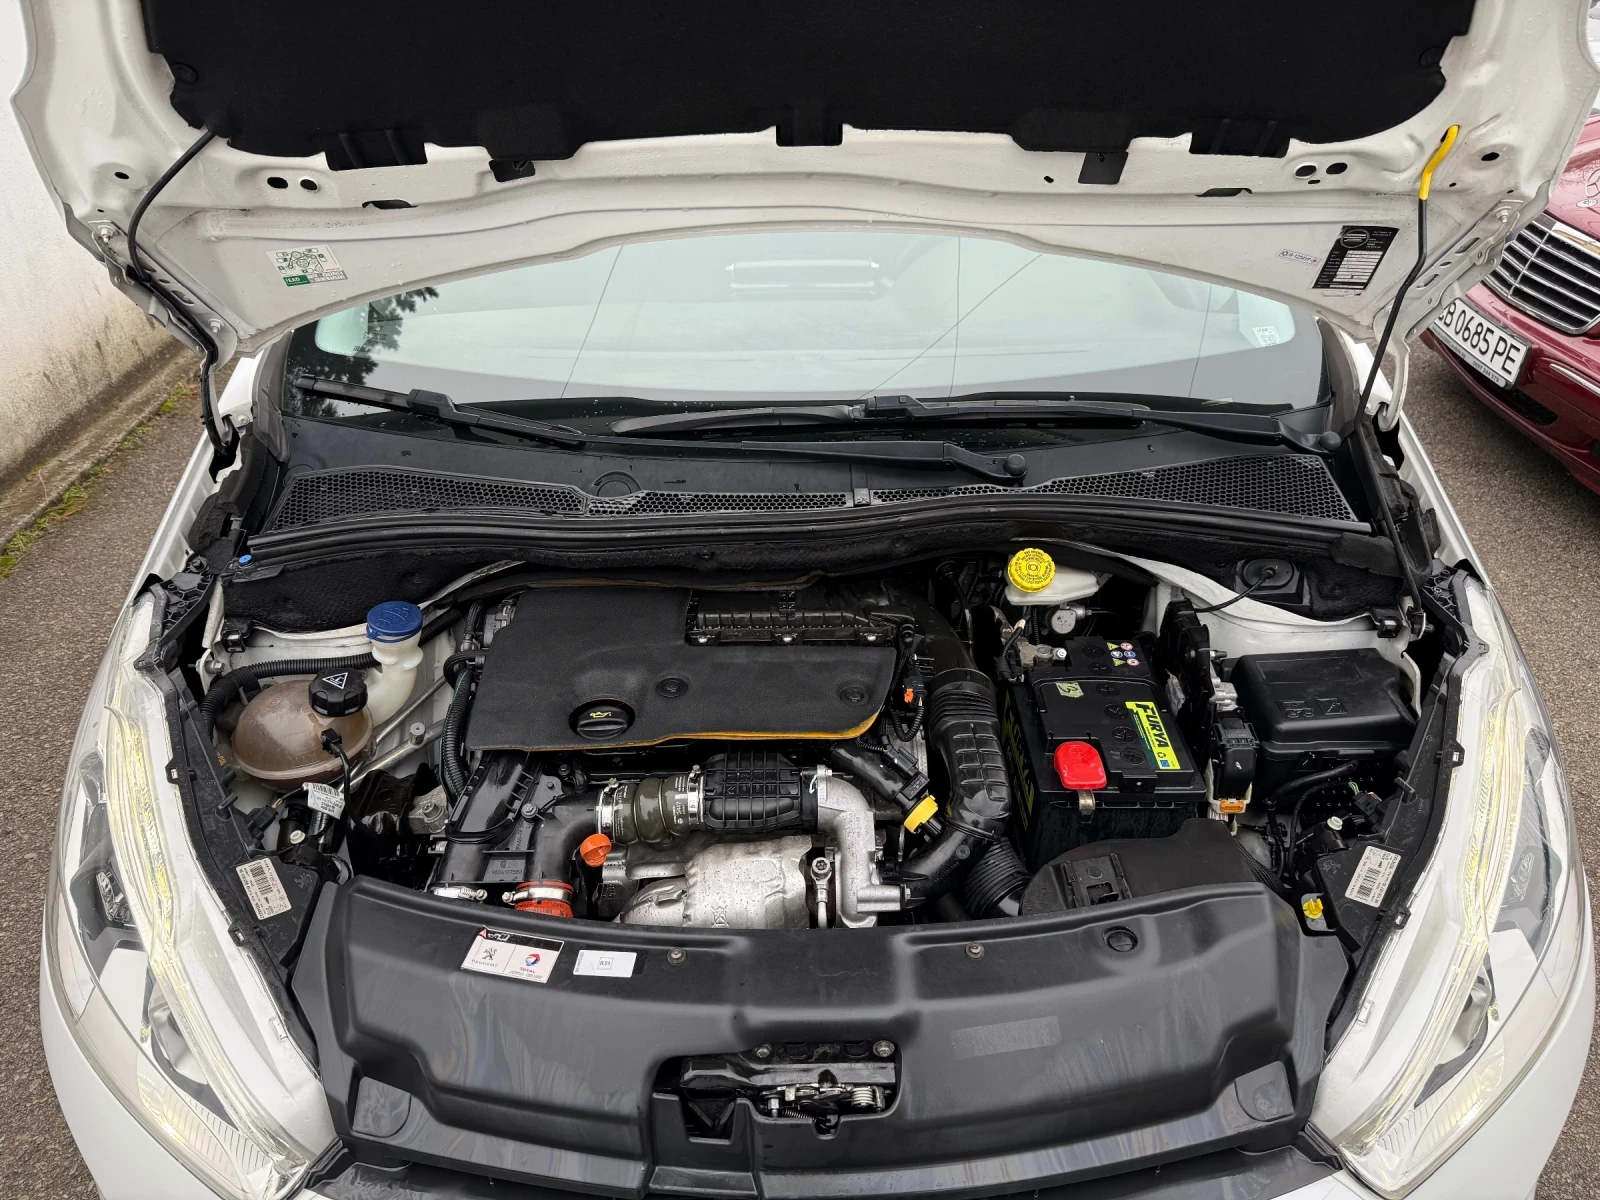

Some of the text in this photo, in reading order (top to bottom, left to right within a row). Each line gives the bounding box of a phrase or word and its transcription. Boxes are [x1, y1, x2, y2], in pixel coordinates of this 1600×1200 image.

[1438, 301, 1457, 328] B
[1454, 309, 1495, 356] 0685
[1489, 330, 1521, 376] PE
[1134, 702, 1170, 748] FURYA
[471, 959, 498, 968] PEUGEOT
